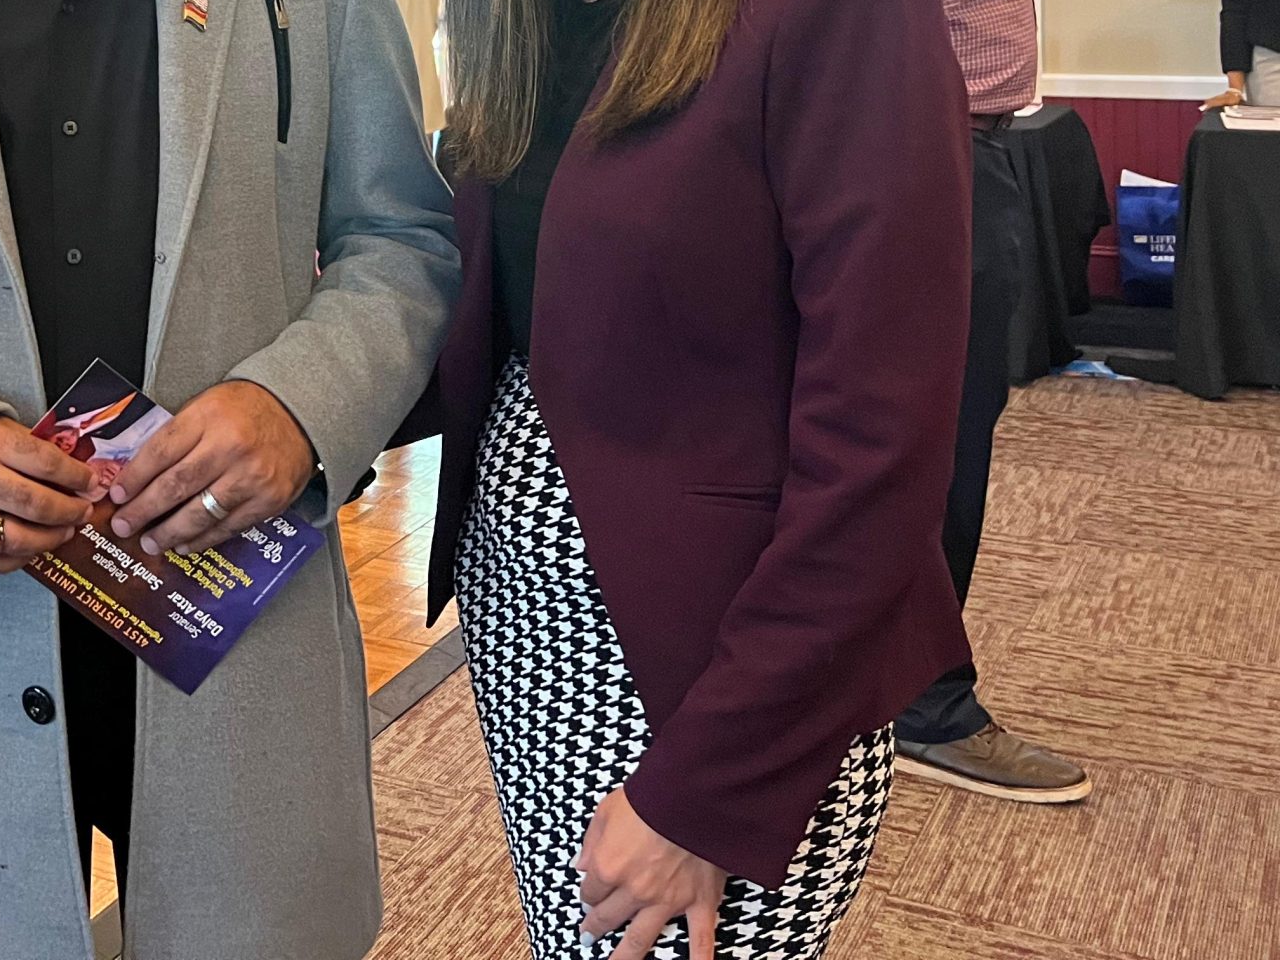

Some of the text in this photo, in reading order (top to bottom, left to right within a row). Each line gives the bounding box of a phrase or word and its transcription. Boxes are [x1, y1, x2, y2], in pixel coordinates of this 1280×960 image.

[80, 524, 163, 590] Sandy Rosenberg
[259, 541, 284, 563] We
[44, 567, 78, 594] UNITY
[92, 552, 129, 584] Delegate
[202, 560, 225, 584] Deliver
[192, 570, 224, 599] Working
[225, 579, 236, 590] to
[76, 591, 125, 629] DISTRICT
[167, 591, 224, 637] Dalya Attar
[124, 627, 149, 648] 41ST
[168, 611, 202, 639] Senator
